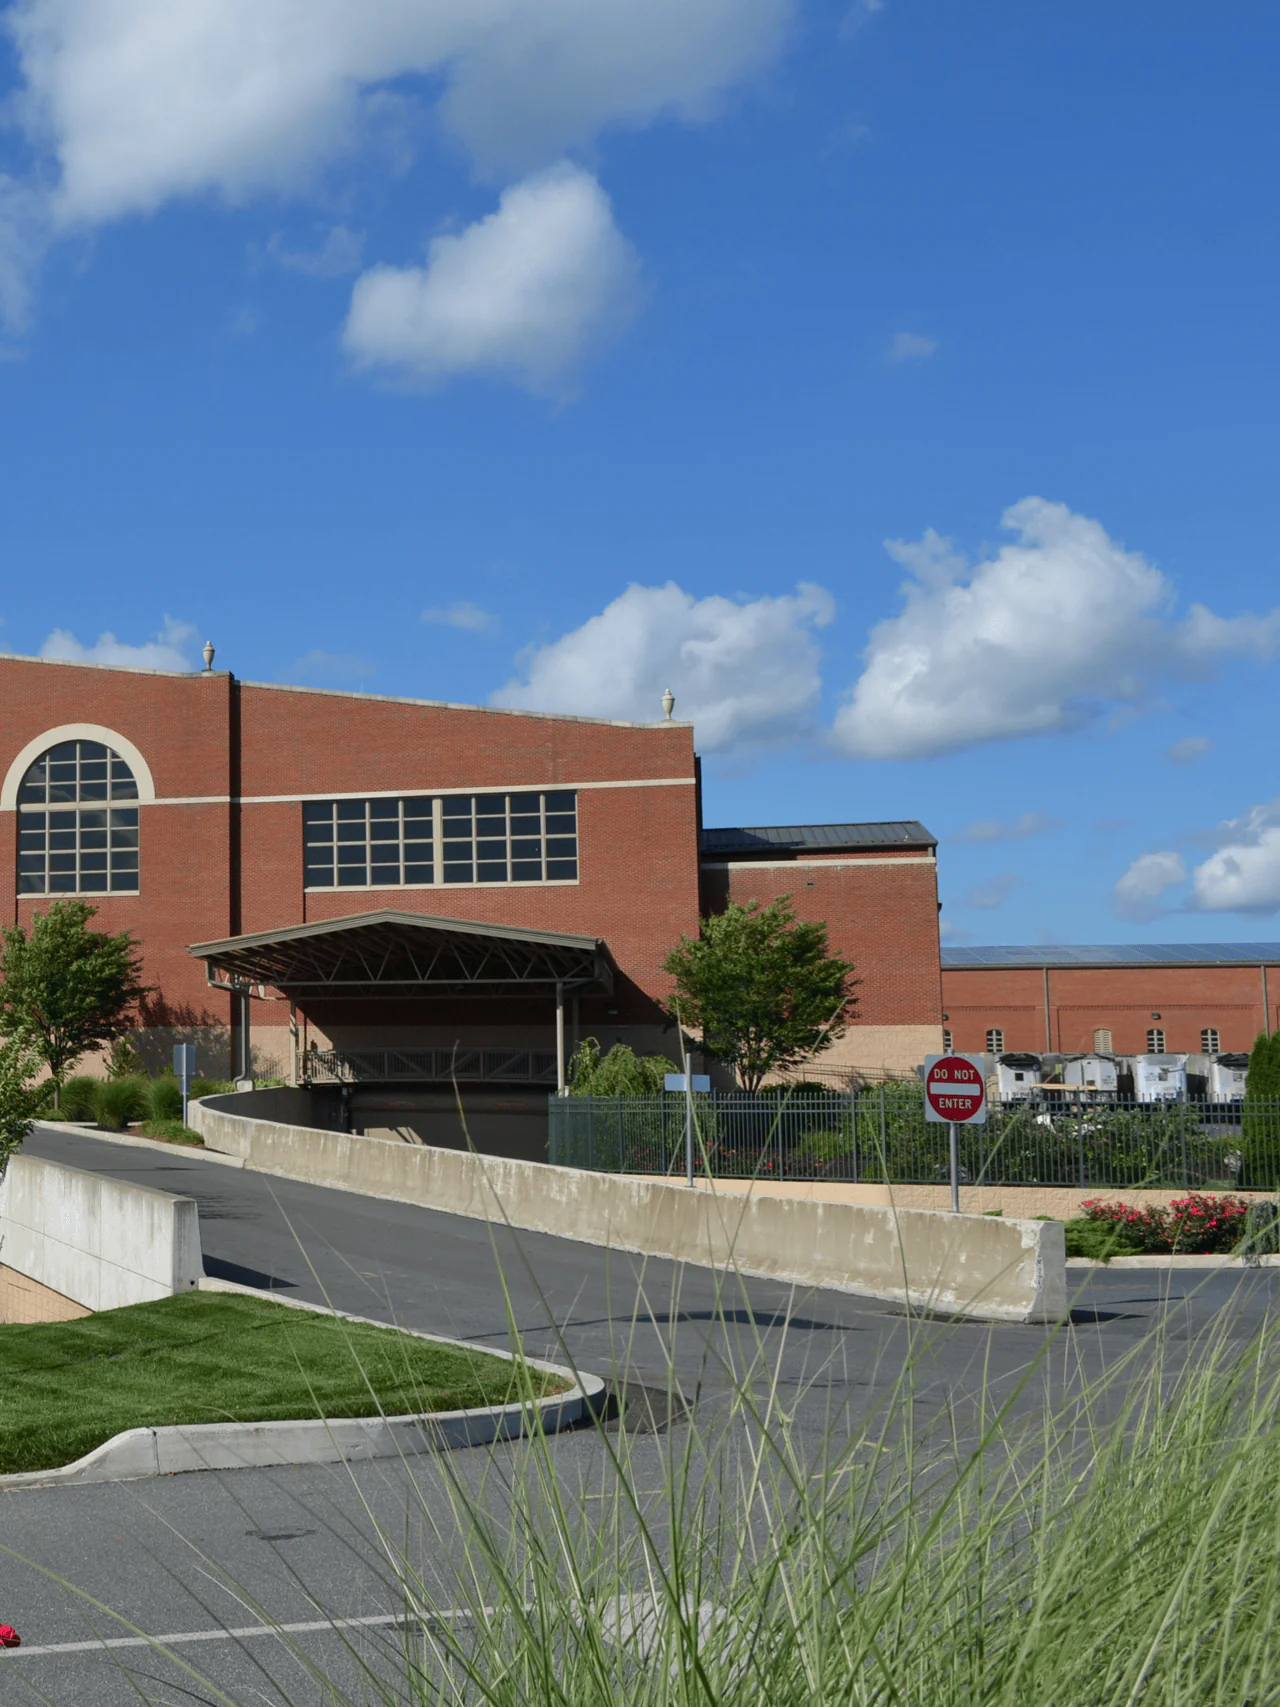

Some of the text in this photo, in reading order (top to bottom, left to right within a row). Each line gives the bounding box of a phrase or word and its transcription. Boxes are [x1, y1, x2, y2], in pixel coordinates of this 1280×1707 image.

[934, 1068, 975, 1080] DO NOT
[939, 1098, 972, 1109] ENTER
